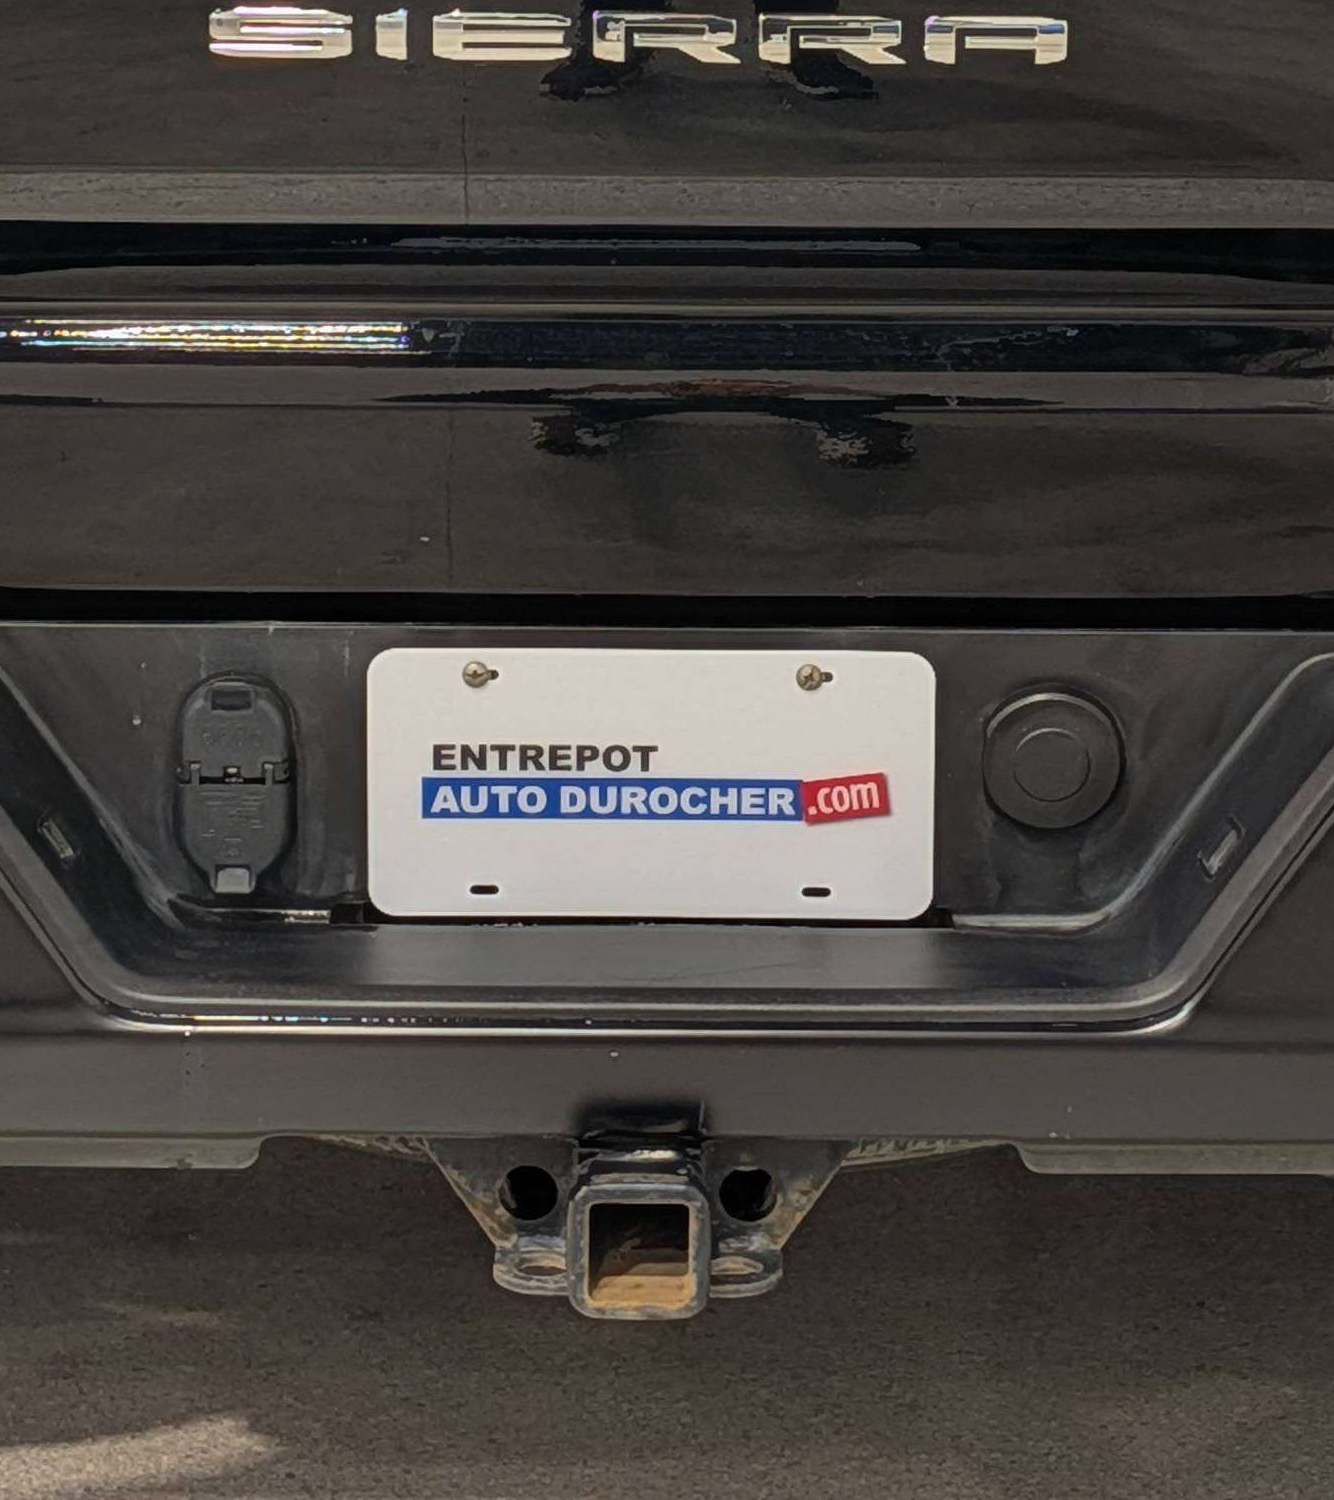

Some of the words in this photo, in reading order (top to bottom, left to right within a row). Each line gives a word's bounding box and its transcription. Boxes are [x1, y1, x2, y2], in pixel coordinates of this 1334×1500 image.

[209, 8, 1069, 66] SIERRA
[432, 744, 659, 772] ENTREPOT
[430, 784, 547, 815] AUTO
[560, 786, 796, 817] DUROCHER
